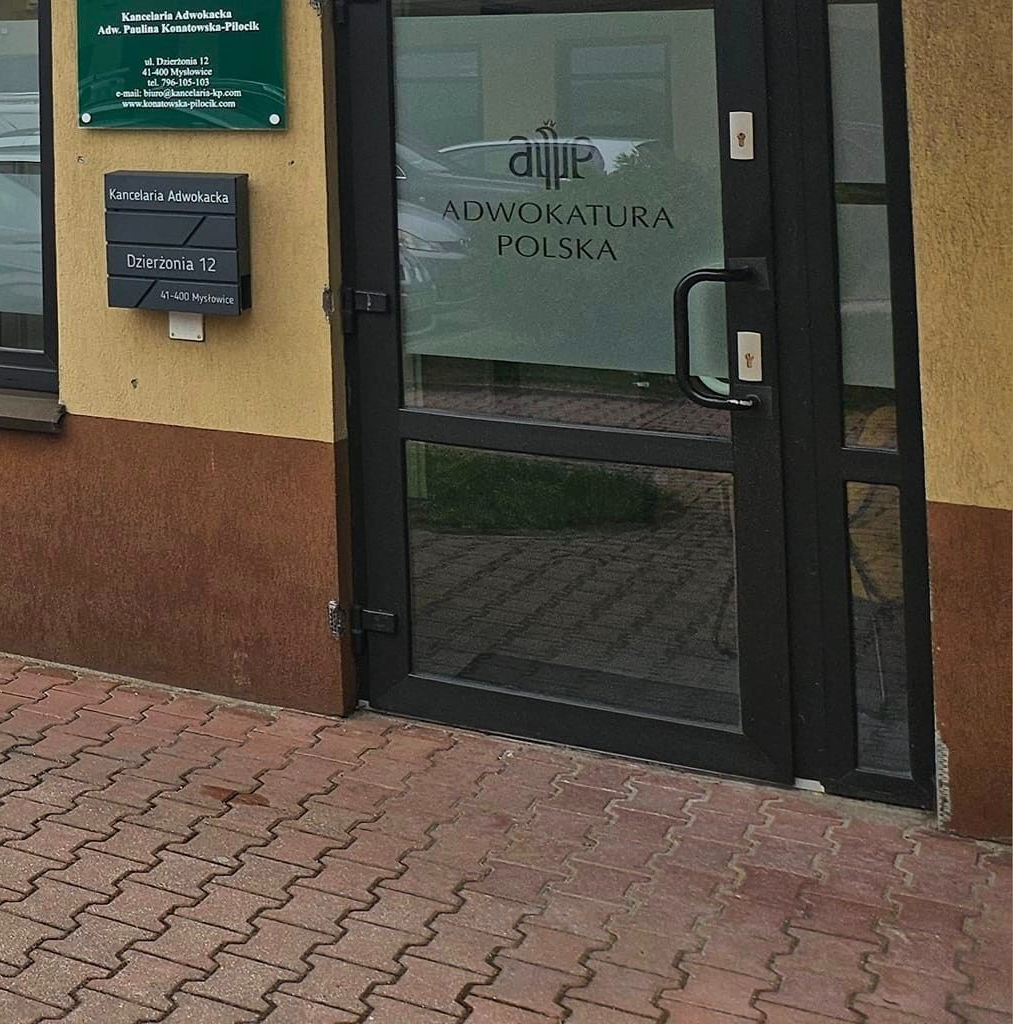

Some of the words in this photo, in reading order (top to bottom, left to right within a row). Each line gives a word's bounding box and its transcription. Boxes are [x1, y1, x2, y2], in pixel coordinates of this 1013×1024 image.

[121, 11, 173, 22] Kancelaria
[175, 9, 232, 20] Adwokacka
[98, 25, 121, 35] Adw.
[123, 23, 159, 34] Paulina
[144, 58, 154, 66] ul.
[200, 57, 209, 65] 12
[142, 69, 169, 77] 41-400
[147, 79, 159, 87] tel.
[162, 78, 210, 87] 796-105-103
[115, 90, 142, 98] e-mail:
[143, 89, 242, 99] biuro@kancelaria-kp.com
[122, 99, 236, 110] www.konatowska-pilocik.com
[109, 188, 164, 202] Kancelaria
[167, 190, 229, 204] Adwokacka
[442, 200, 674, 229] ADWOKATURA
[498, 234, 617, 261] POLSKA
[126, 254, 194, 271] Dzierżonia
[199, 257, 216, 272] 12
[160, 290, 190, 301] 41-400
[192, 292, 235, 305] Mysłowice
